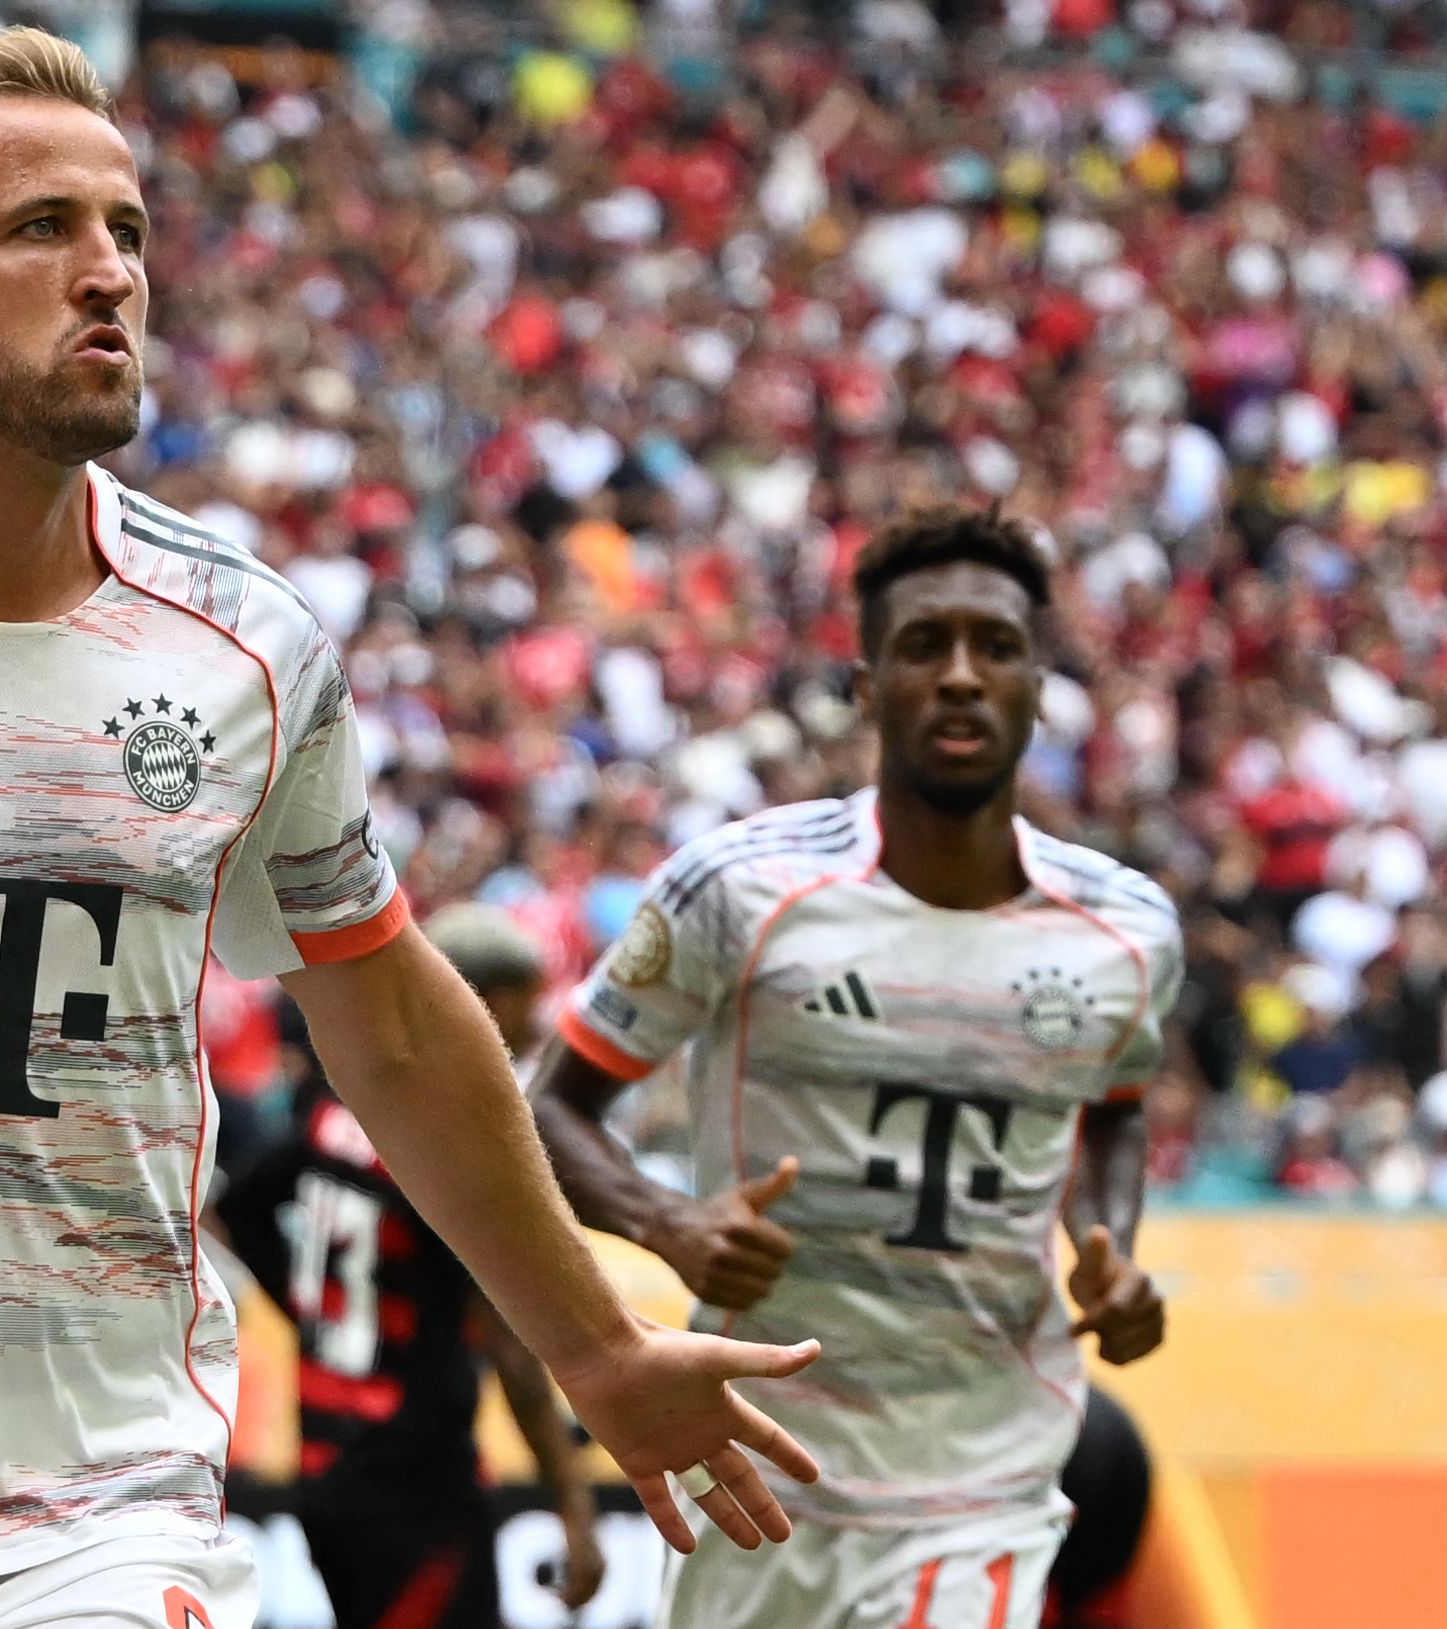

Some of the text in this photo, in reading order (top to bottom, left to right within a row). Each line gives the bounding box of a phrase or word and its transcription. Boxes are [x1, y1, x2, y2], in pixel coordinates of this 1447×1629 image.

[131, 727, 196, 765] FC BAYERN
[867, 1080, 1013, 1252] T
[893, 1551, 1016, 1629] 11
